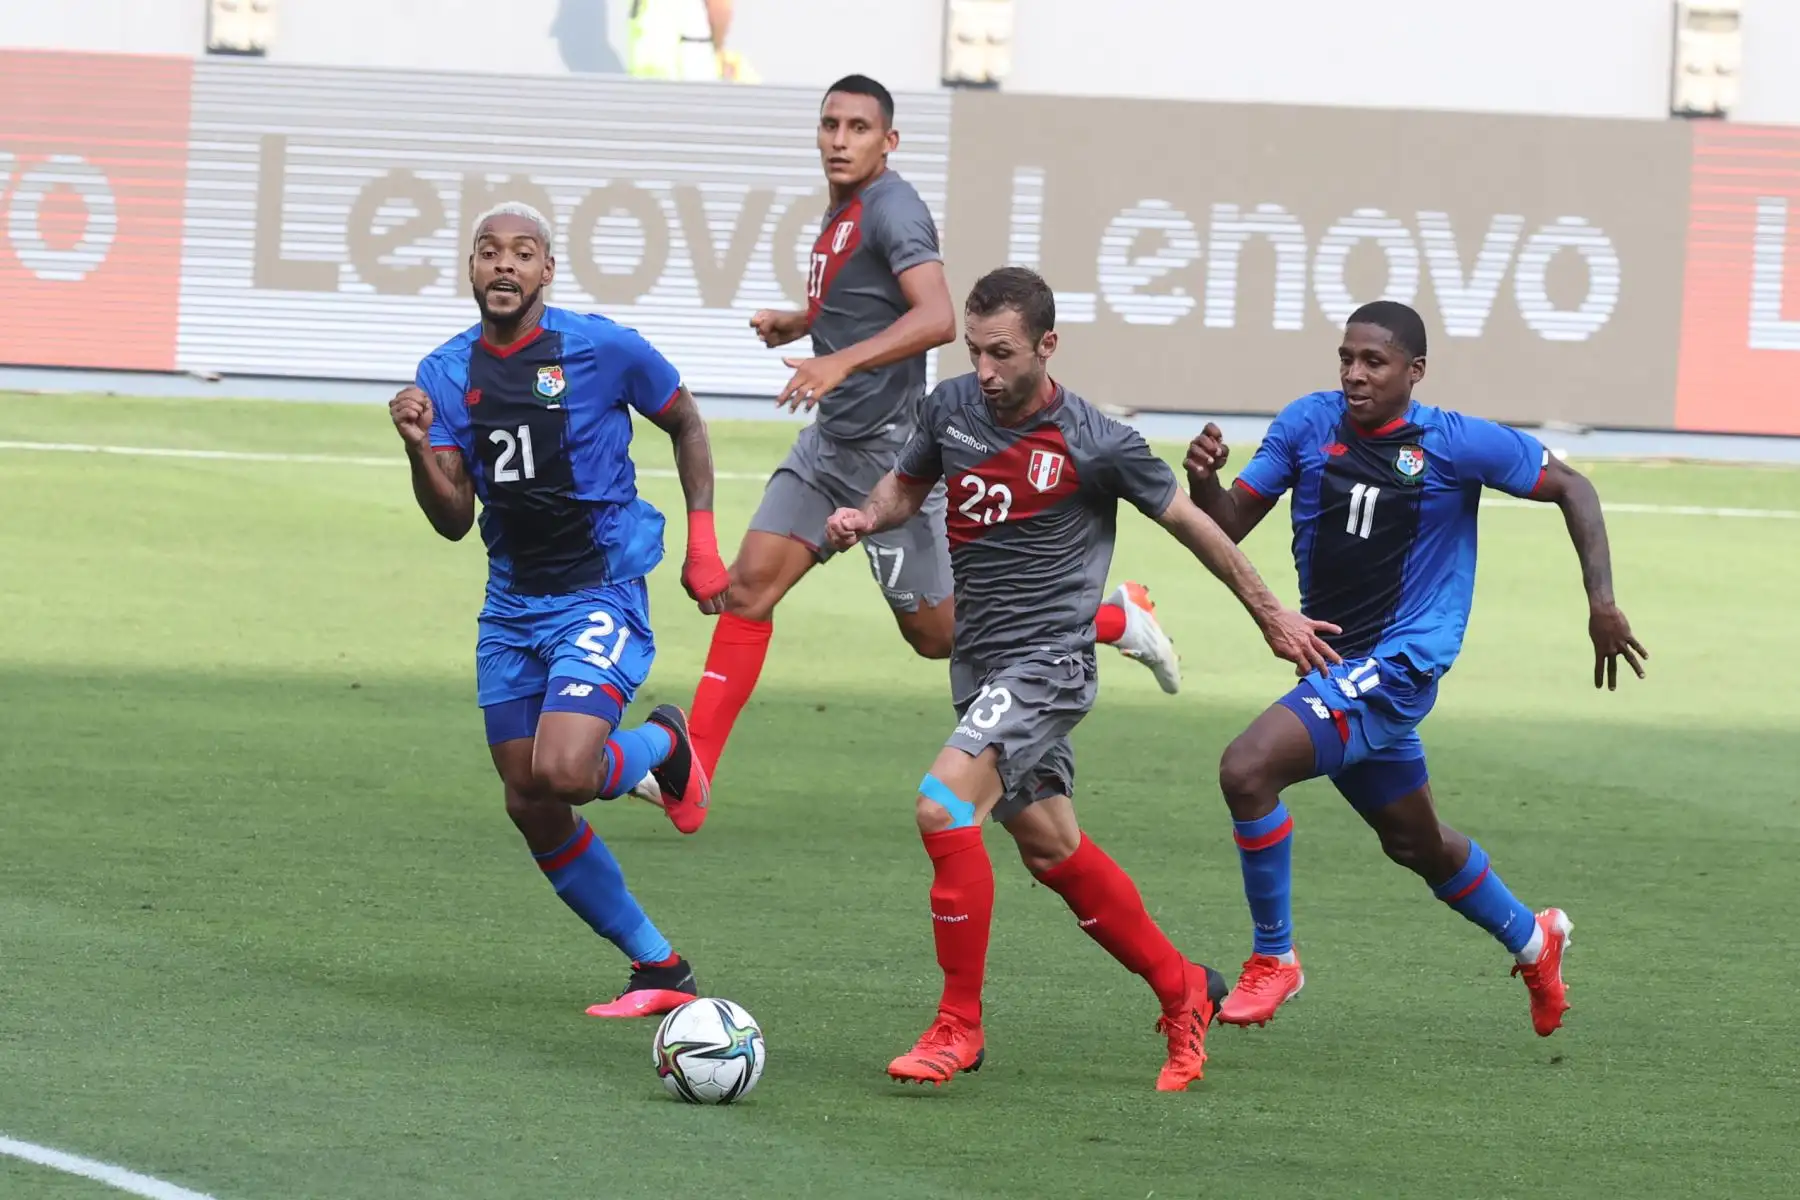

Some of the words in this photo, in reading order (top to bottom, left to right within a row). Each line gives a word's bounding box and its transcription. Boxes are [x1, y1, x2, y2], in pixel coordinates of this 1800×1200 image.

[1006, 166, 1621, 340] Lenovo
[488, 424, 536, 483] 21
[946, 425, 988, 454] marathon
[958, 474, 1012, 526] 23
[1345, 482, 1380, 539] 11
[867, 544, 905, 588] 17
[574, 610, 631, 665] 21
